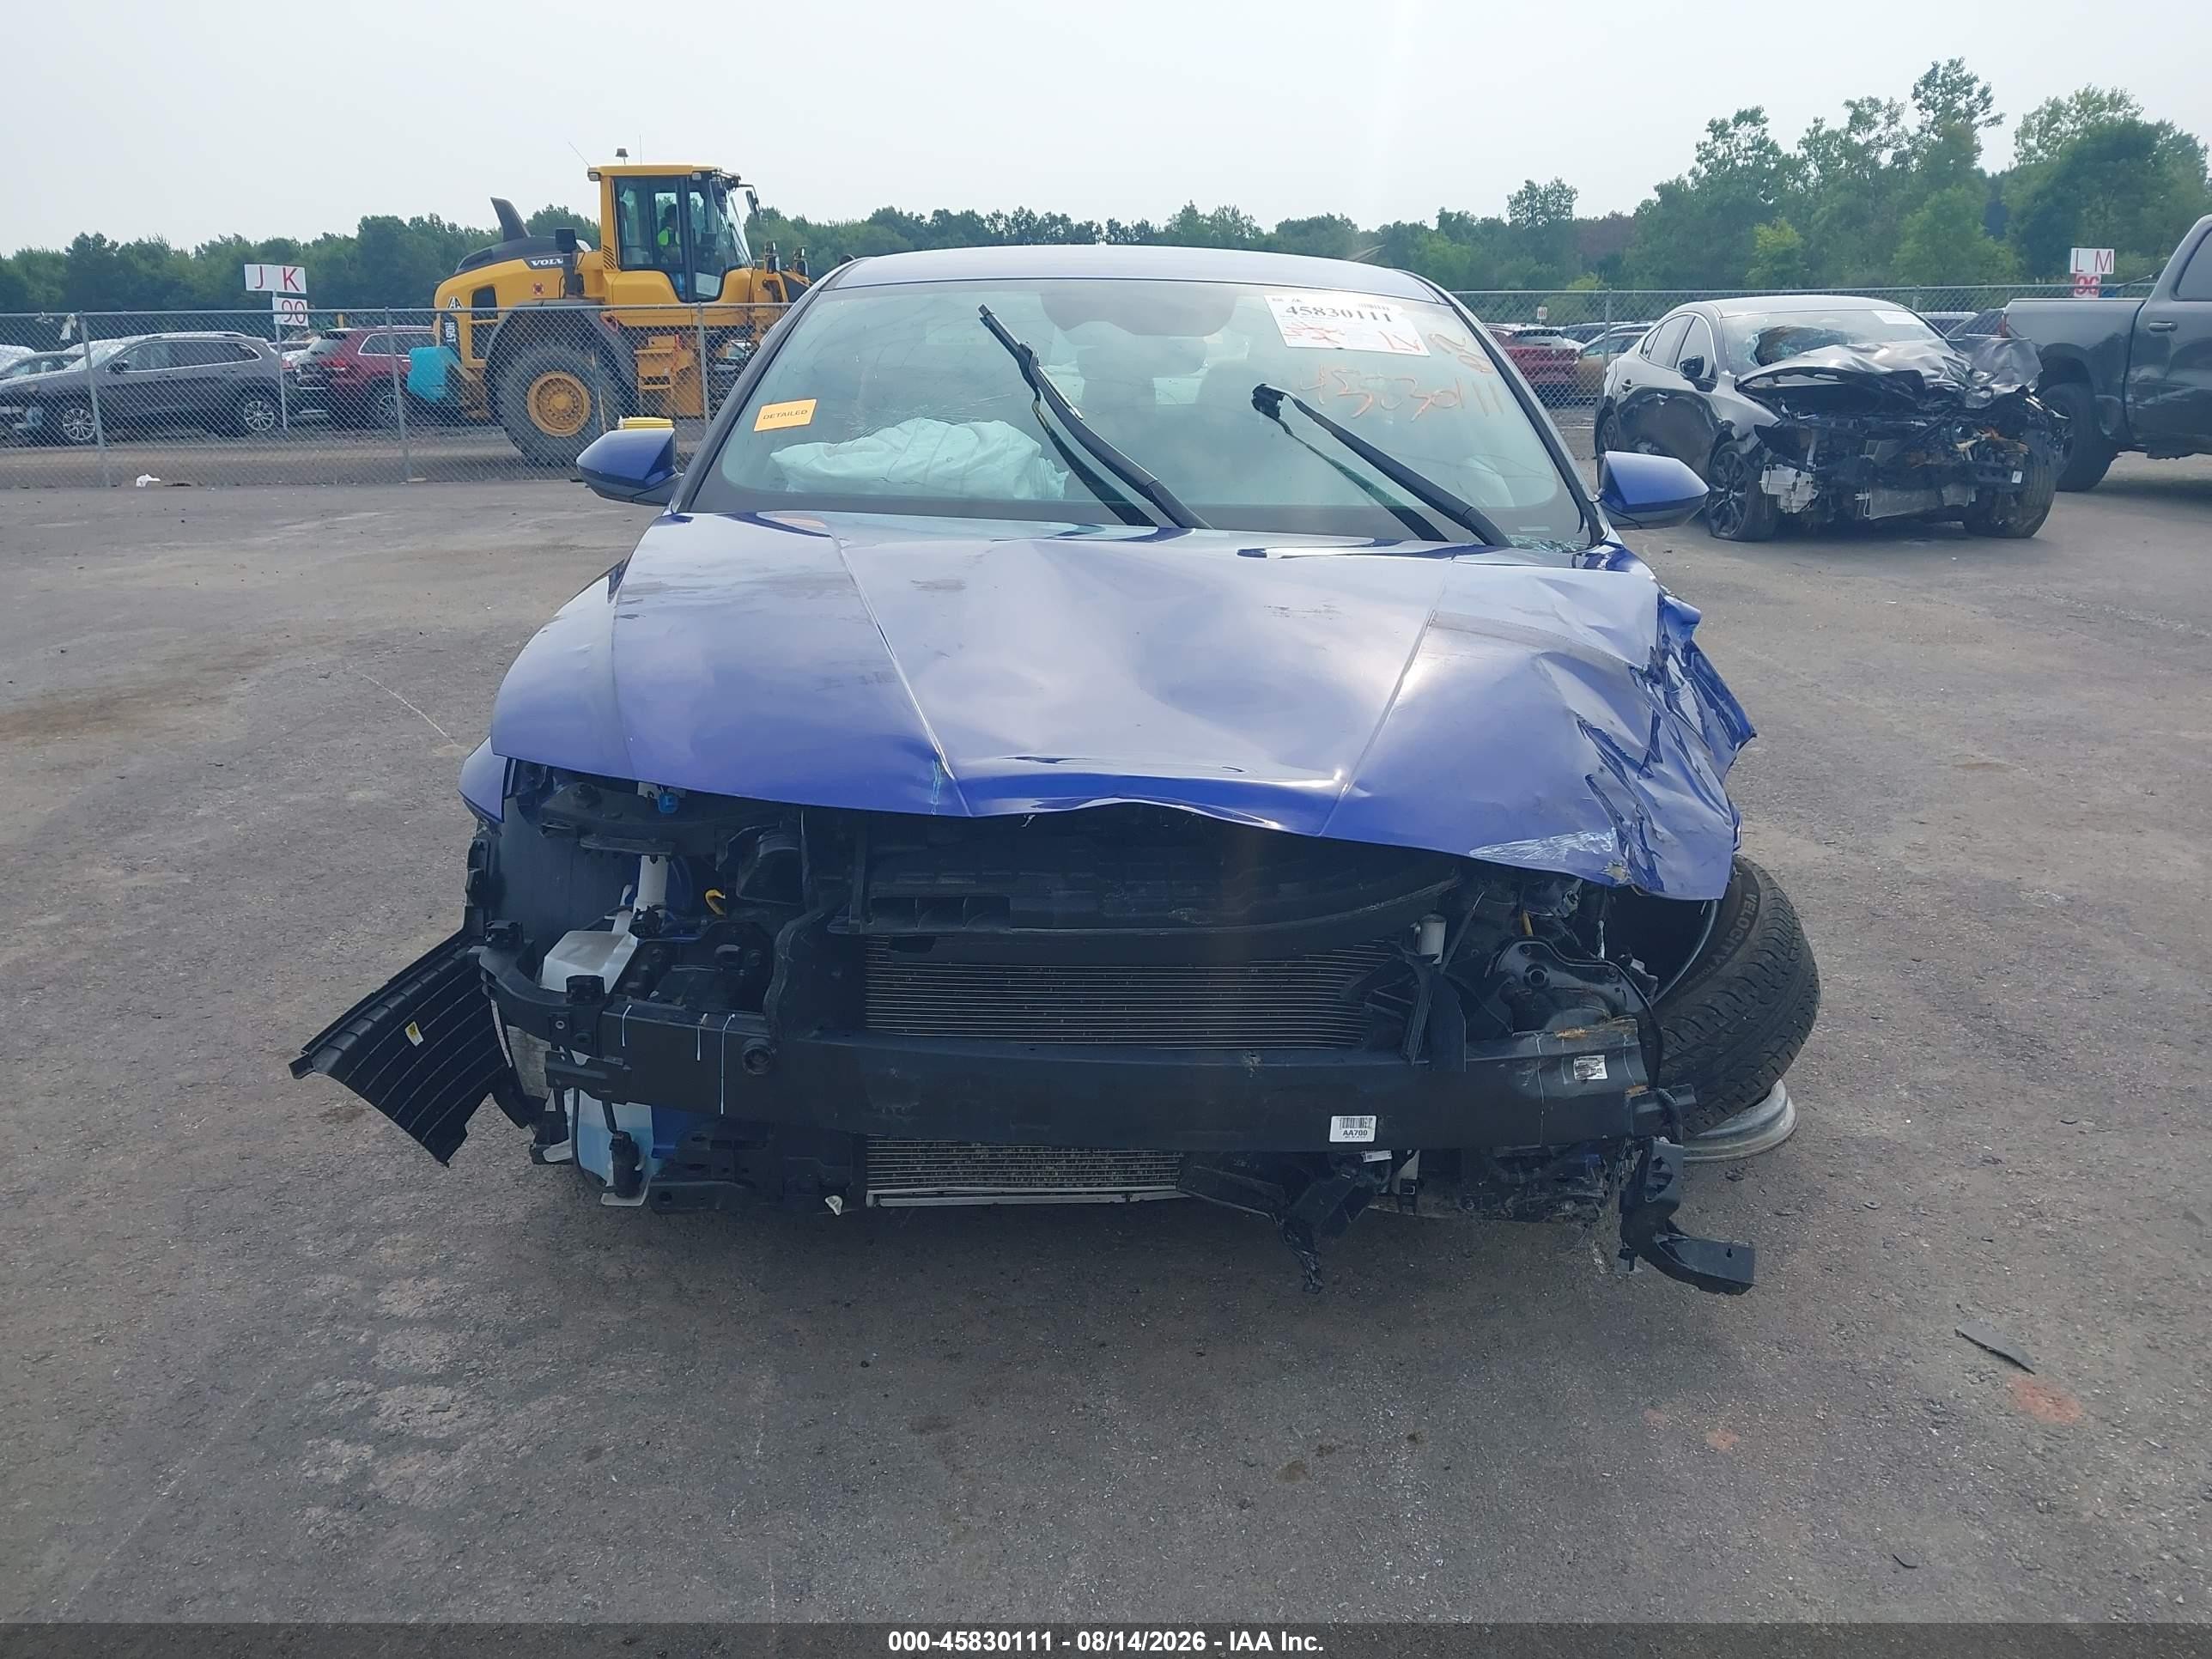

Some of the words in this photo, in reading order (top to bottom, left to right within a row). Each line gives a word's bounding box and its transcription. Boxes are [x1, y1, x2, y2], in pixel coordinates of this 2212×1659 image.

[531, 258, 564, 266] VOLV
[2075, 250, 2084, 272] L
[2095, 250, 2112, 272] M
[254, 265, 264, 289] J
[283, 267, 301, 292] K
[282, 300, 306, 324] 90
[1285, 306, 1393, 322] 45830111
[763, 410, 808, 420] DETAILED
